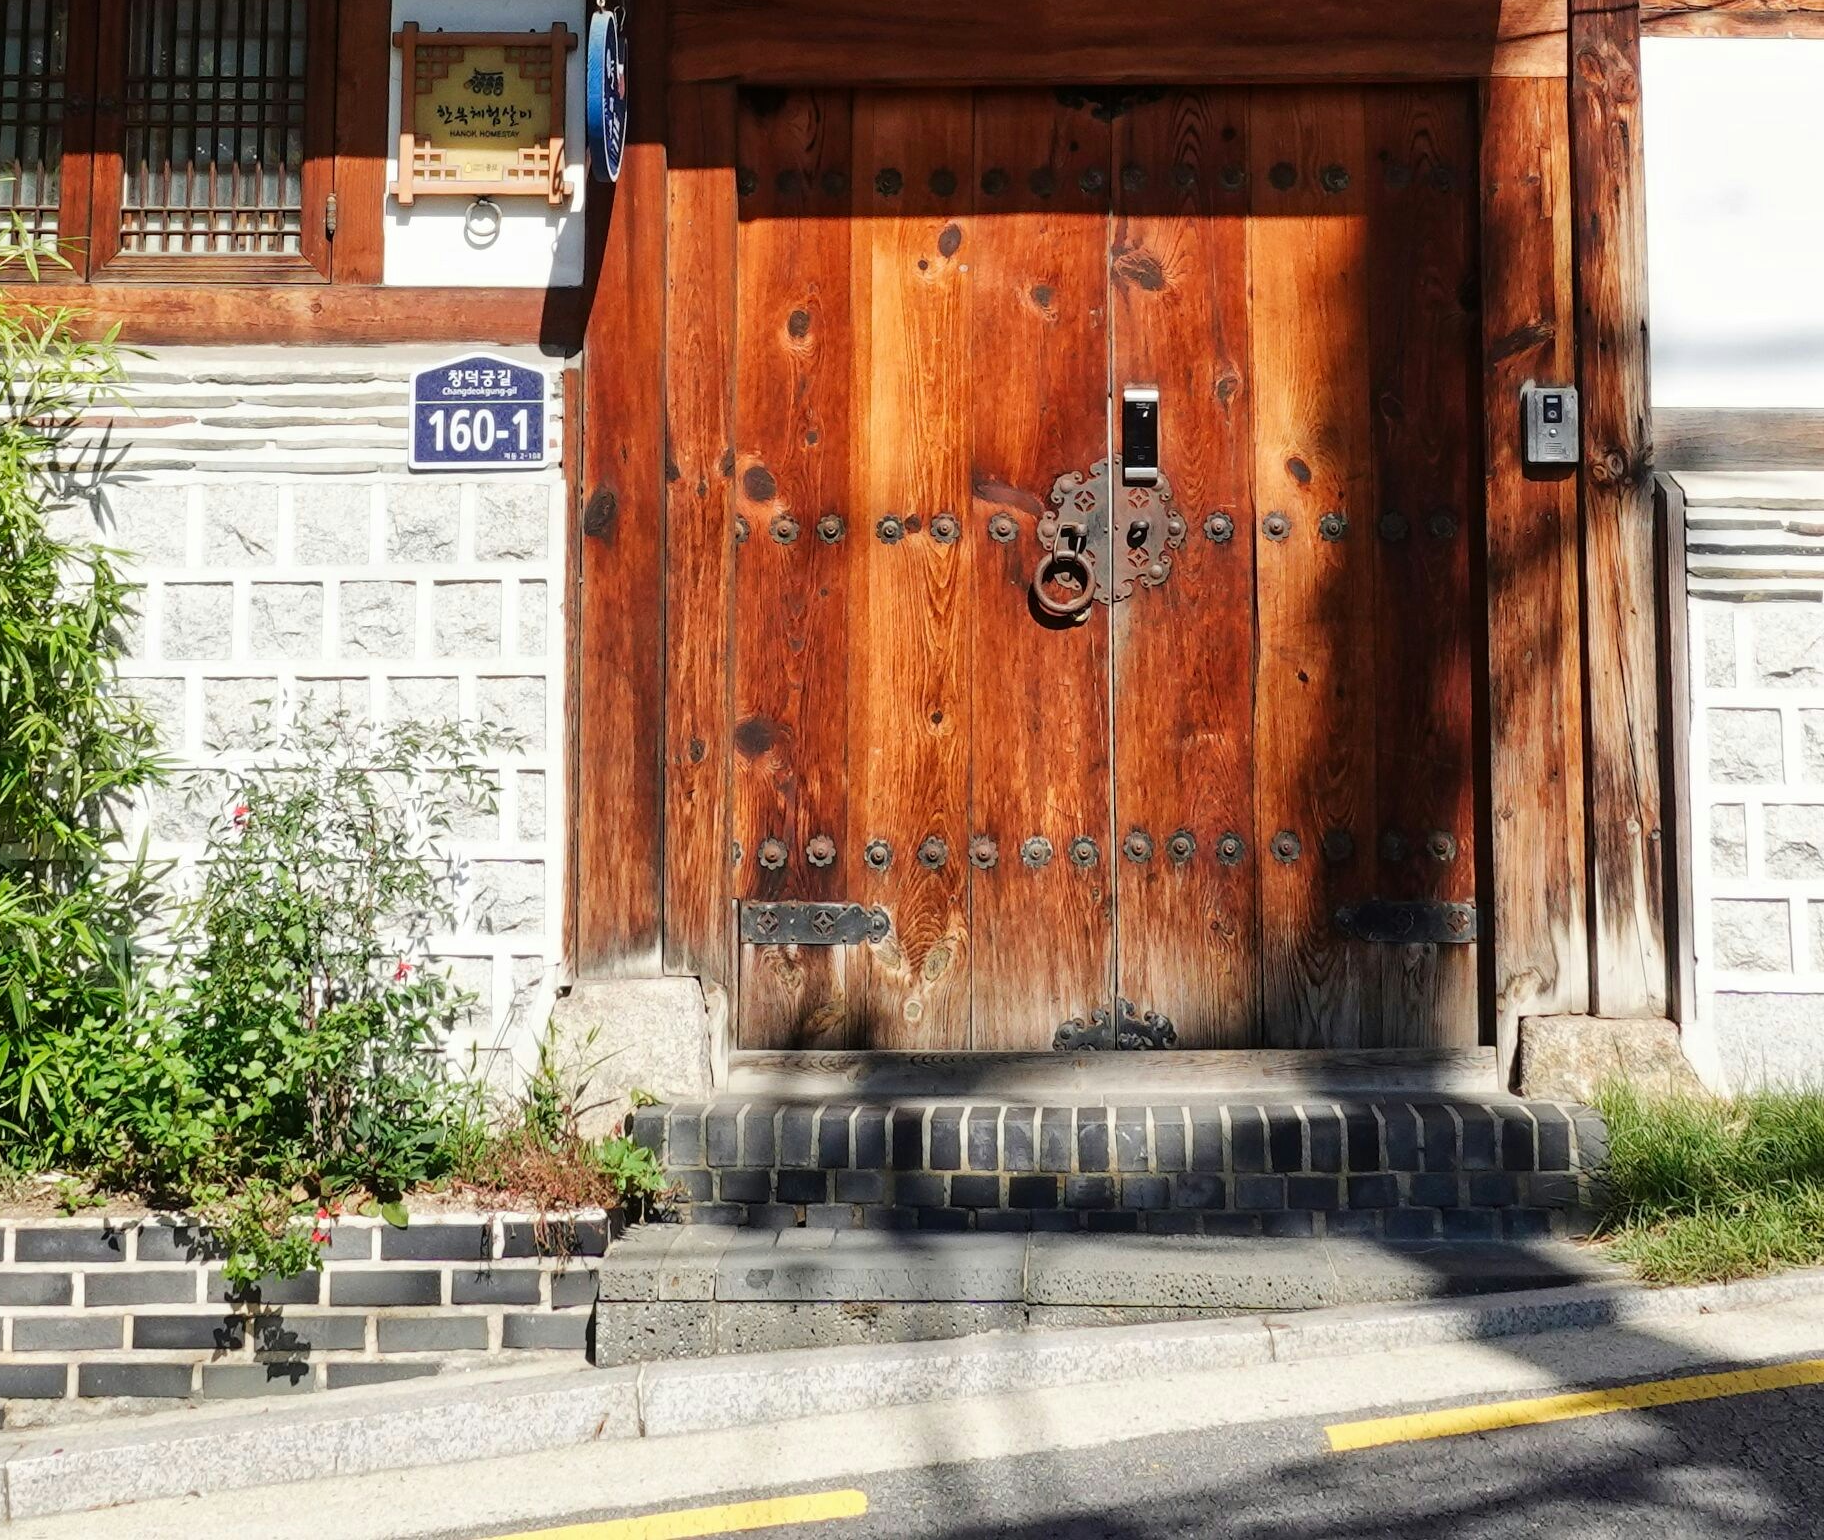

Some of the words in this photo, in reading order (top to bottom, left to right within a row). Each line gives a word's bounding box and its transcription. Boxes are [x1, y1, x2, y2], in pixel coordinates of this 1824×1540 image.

[449, 130, 477, 138] HANOK
[479, 130, 520, 138] HOMESTAY
[447, 369, 512, 388] 창덕궁길
[441, 386, 518, 397] Changdeokgung-gil
[428, 408, 528, 452] 160-1
